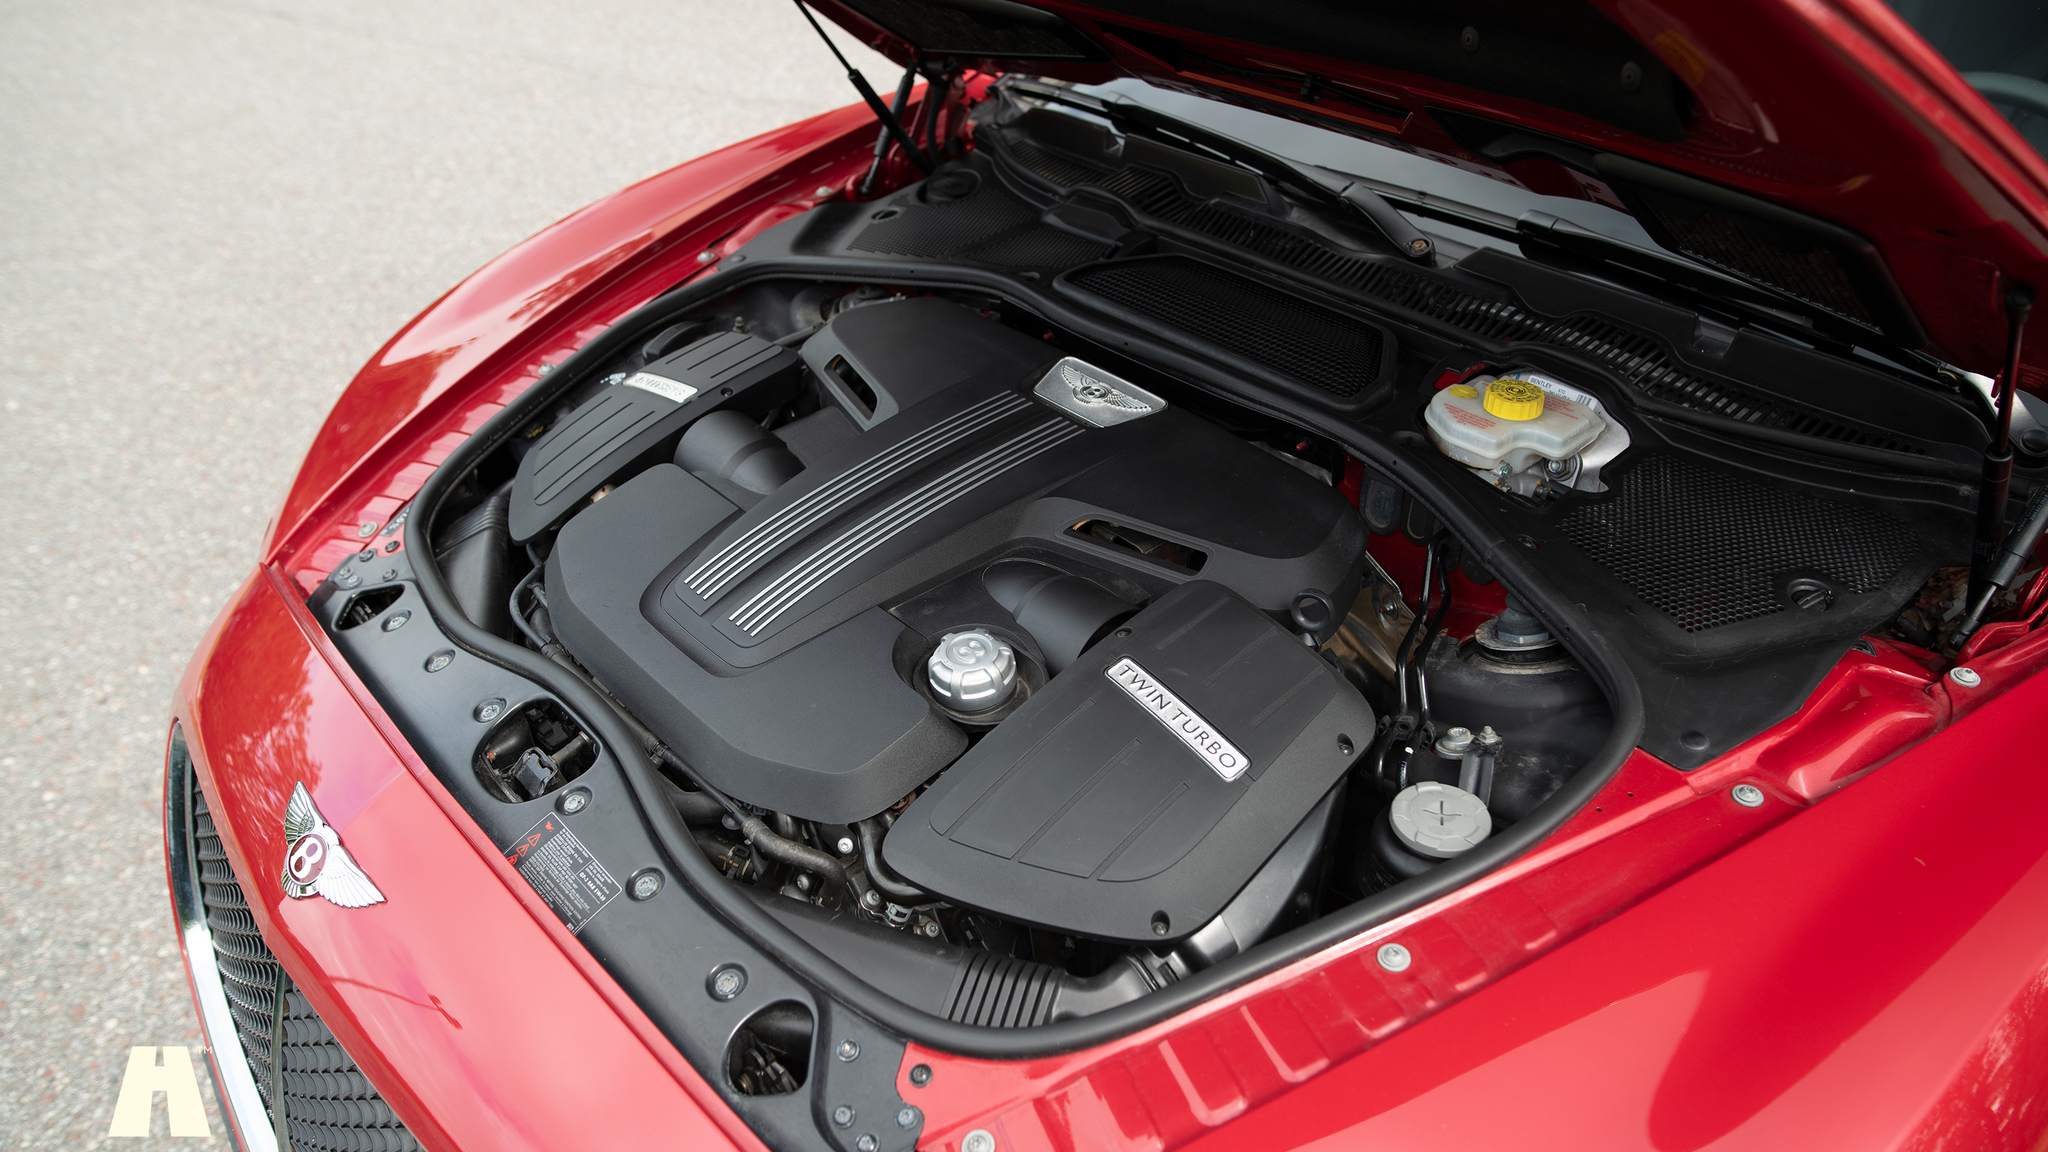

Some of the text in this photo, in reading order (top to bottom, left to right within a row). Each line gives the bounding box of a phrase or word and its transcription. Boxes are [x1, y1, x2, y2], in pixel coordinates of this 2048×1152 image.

[1529, 377, 1552, 389] BENTLEY
[1119, 664, 1237, 769] TWIN TURBO
